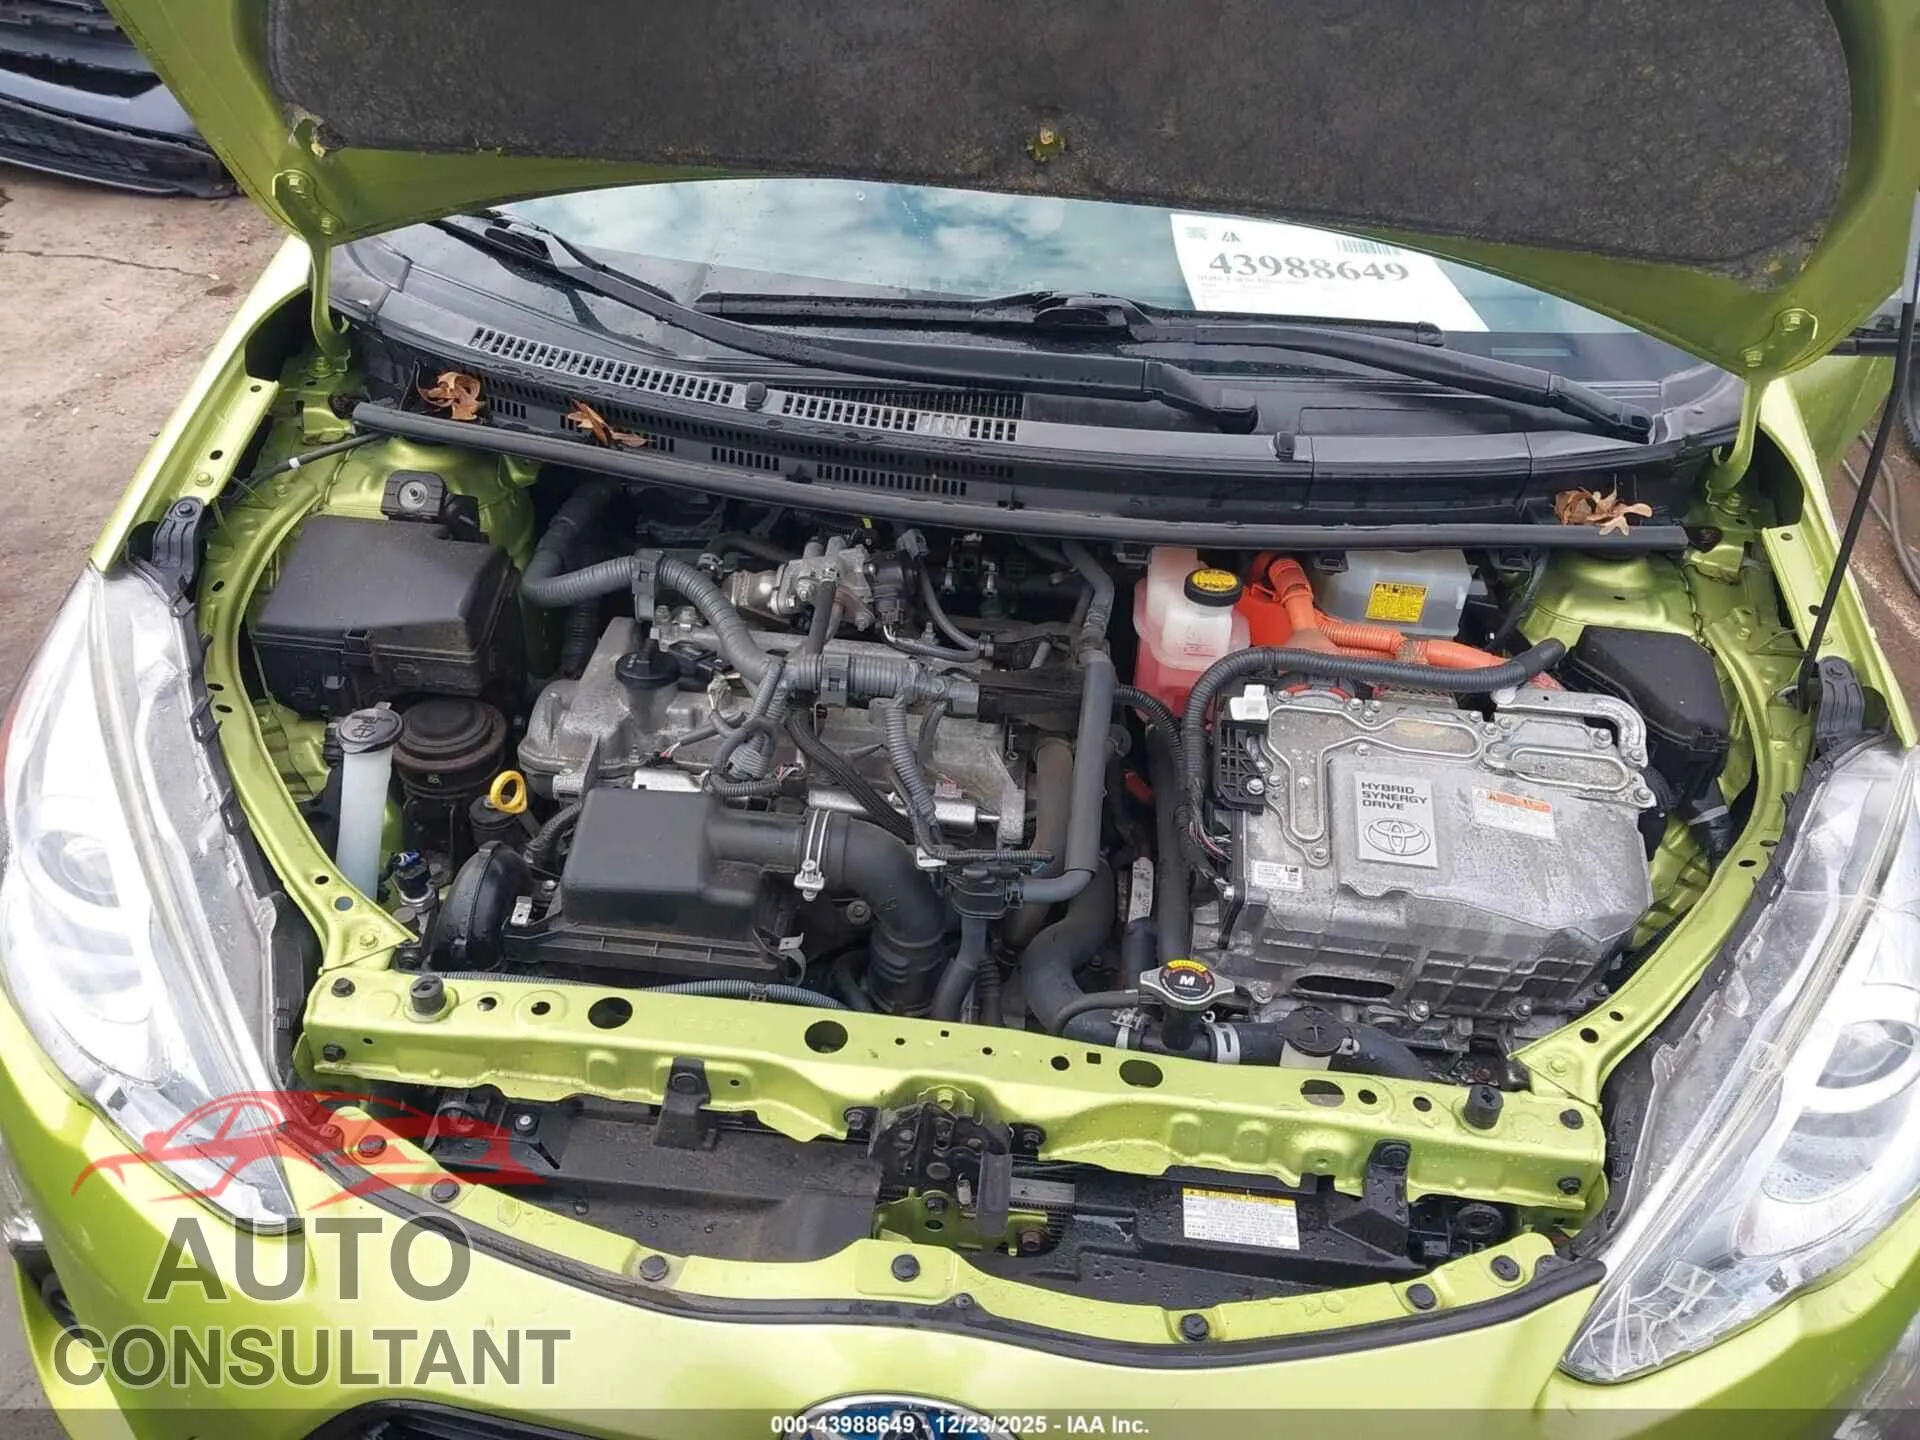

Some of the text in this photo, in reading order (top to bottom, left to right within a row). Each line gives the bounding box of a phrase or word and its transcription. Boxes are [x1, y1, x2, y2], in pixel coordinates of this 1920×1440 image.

[1208, 252, 1409, 281] 43988649
[1361, 782, 1415, 794] HYBRID
[1362, 790, 1428, 804] SYNERGY
[1362, 800, 1405, 811] DRIVE
[1179, 975, 1196, 986] M
